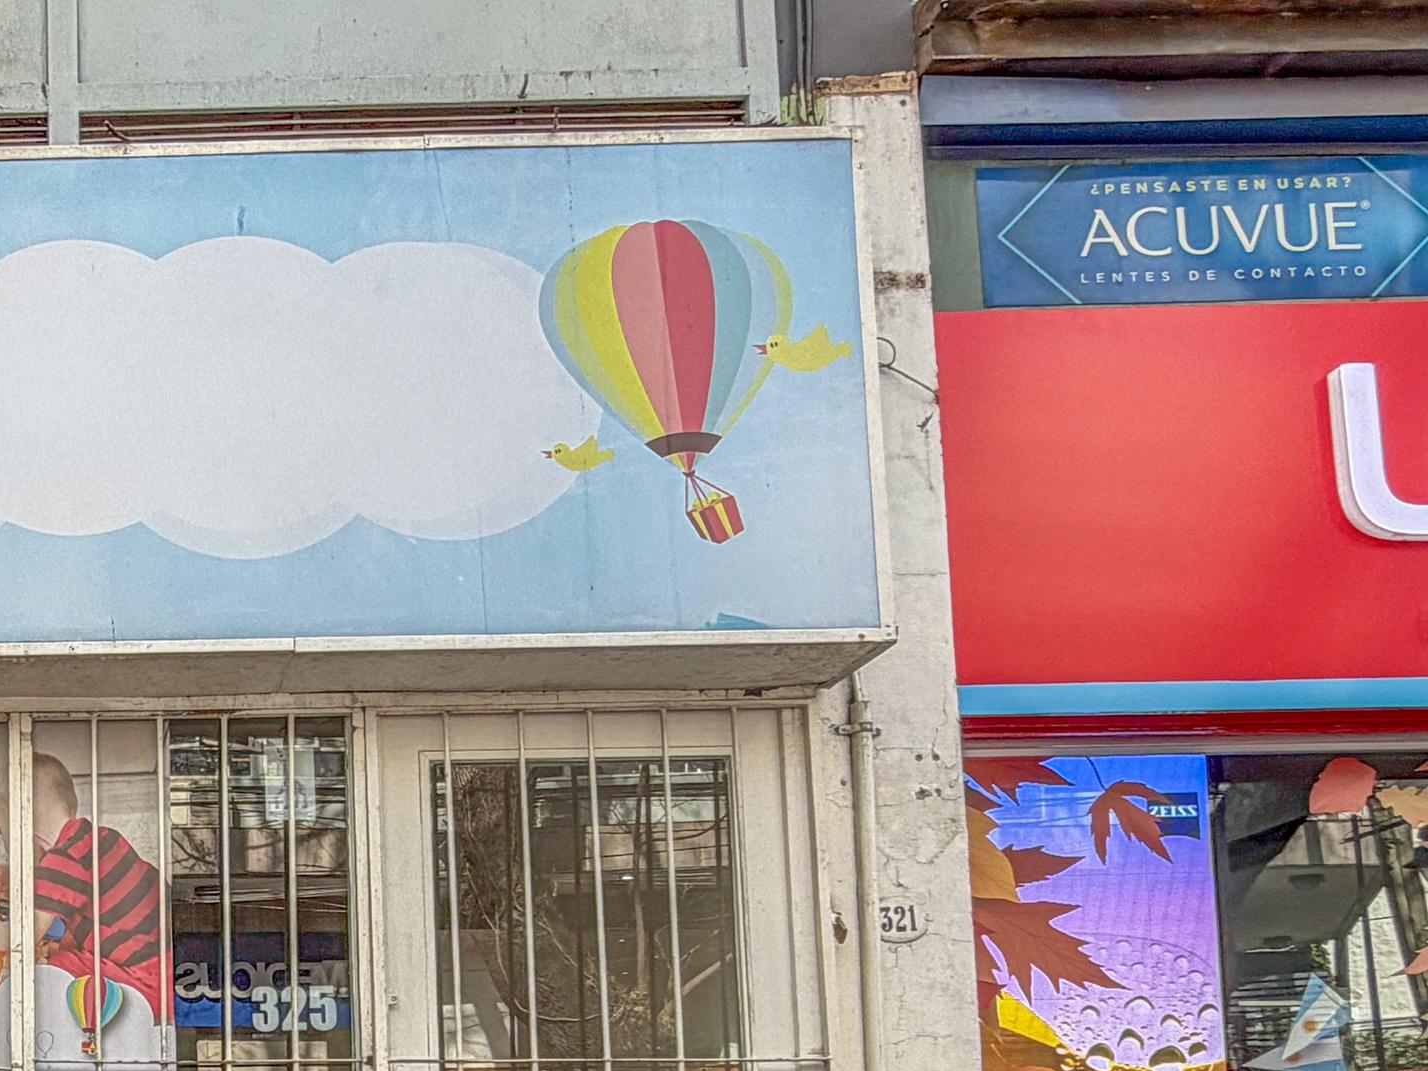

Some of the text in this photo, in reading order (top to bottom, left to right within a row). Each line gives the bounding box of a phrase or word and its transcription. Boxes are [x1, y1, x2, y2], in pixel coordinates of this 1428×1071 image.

[1090, 176, 1352, 195] ¿PENSASTE EN USAR?
[1080, 266, 1367, 284] LENTES DE CONTACTO
[879, 905, 918, 932] 321
[251, 985, 338, 1033] 325
